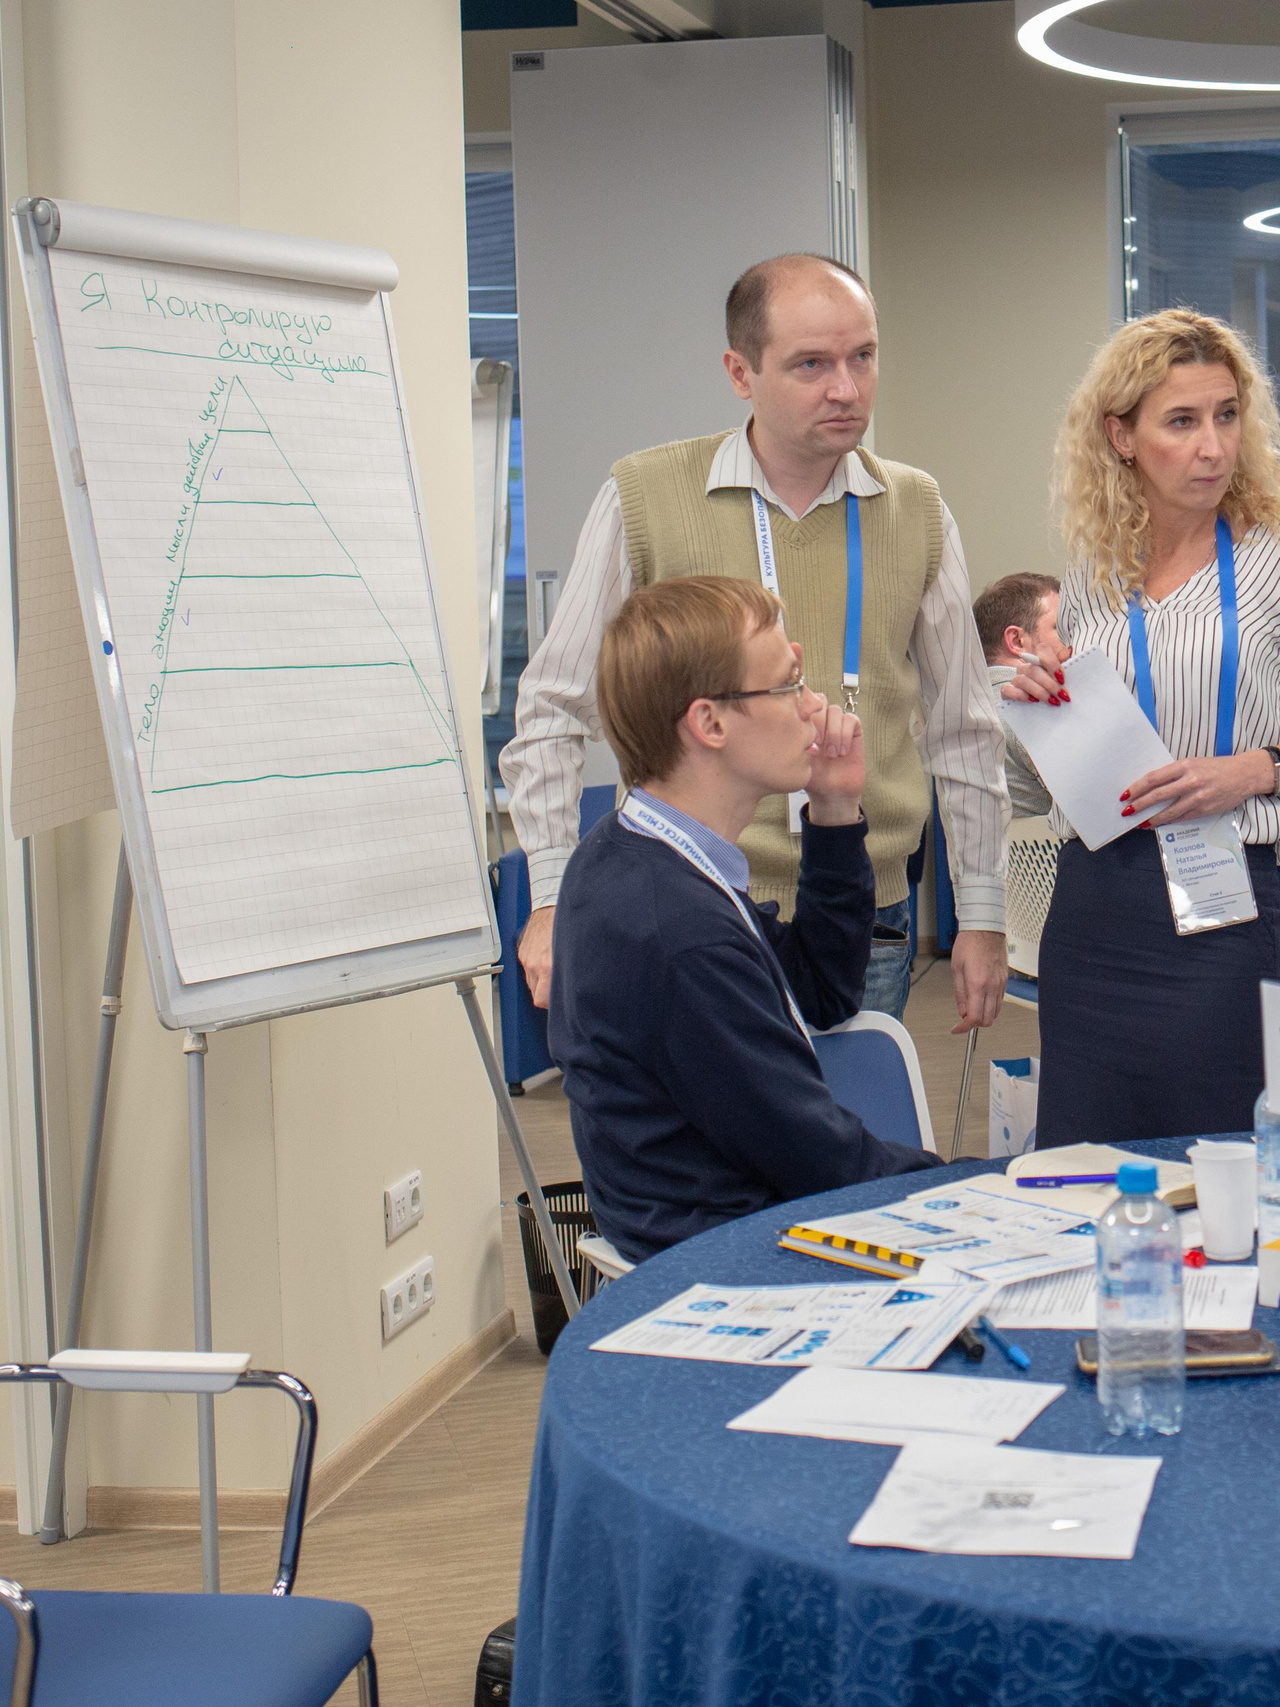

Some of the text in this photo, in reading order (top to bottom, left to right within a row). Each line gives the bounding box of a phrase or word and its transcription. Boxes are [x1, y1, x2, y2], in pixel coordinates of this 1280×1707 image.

[80, 272, 112, 312] Я
[762, 534, 772, 577] КУЛЬТУРА
[638, 810, 659, 827] МЕНЯ
[1173, 842, 1206, 855] Козлова
[1175, 852, 1207, 865] Наталья
[1178, 857, 1235, 876] Владимировна
